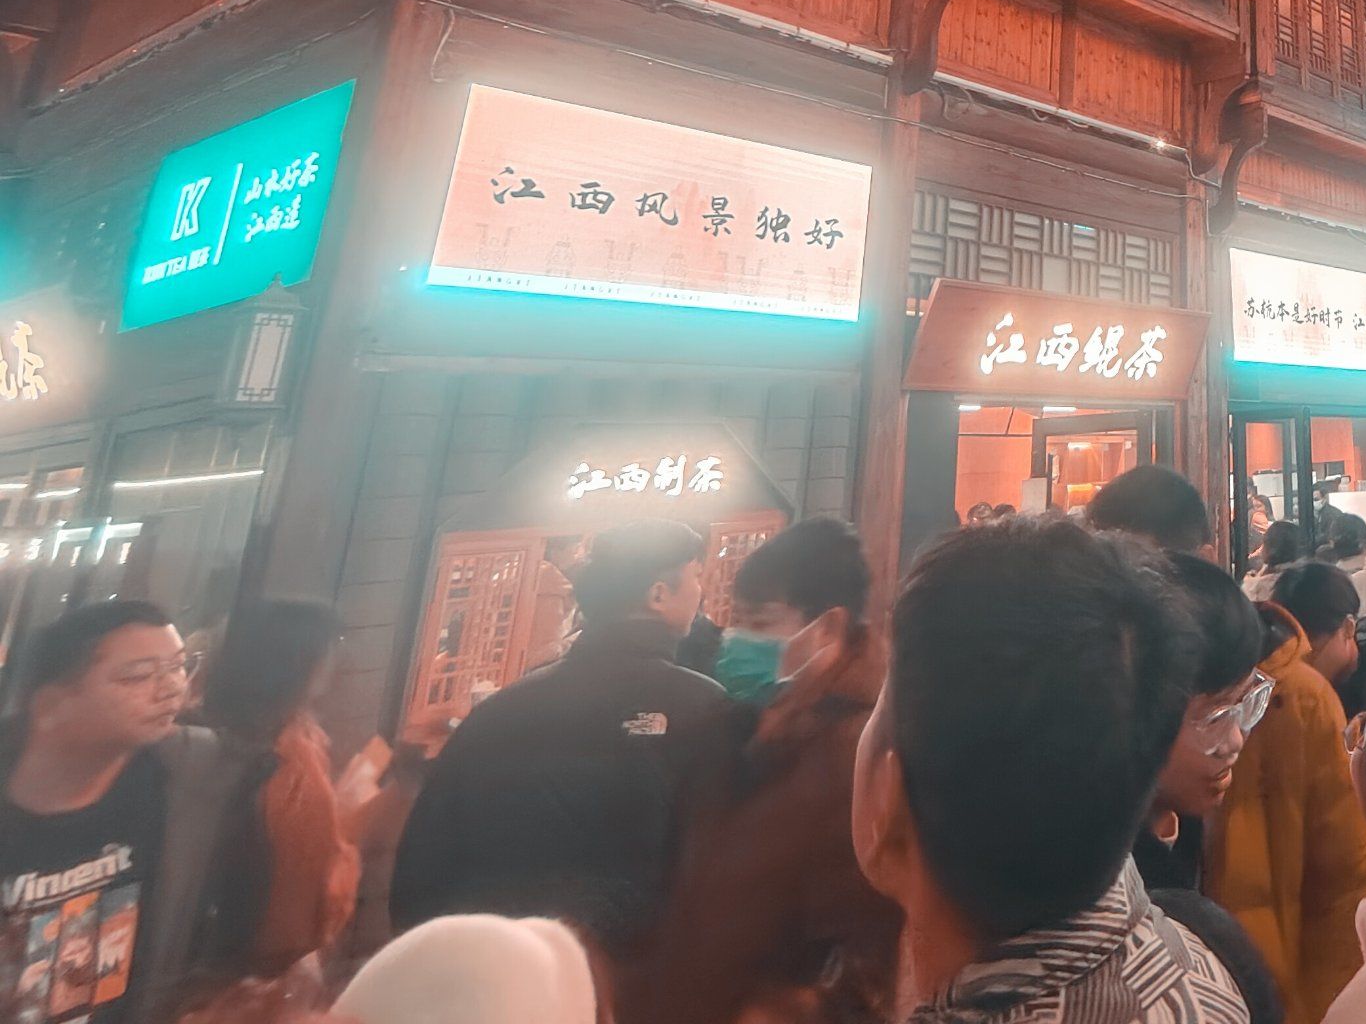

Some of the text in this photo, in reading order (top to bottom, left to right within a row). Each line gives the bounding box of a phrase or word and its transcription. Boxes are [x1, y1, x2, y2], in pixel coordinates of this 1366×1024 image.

[490, 166, 845, 250] 江西风景独好
[1244, 296, 1344, 330] 苏杭本是好时节
[980, 312, 1168, 381] 江西鲲茶
[567, 453, 725, 500] 江西制茶
